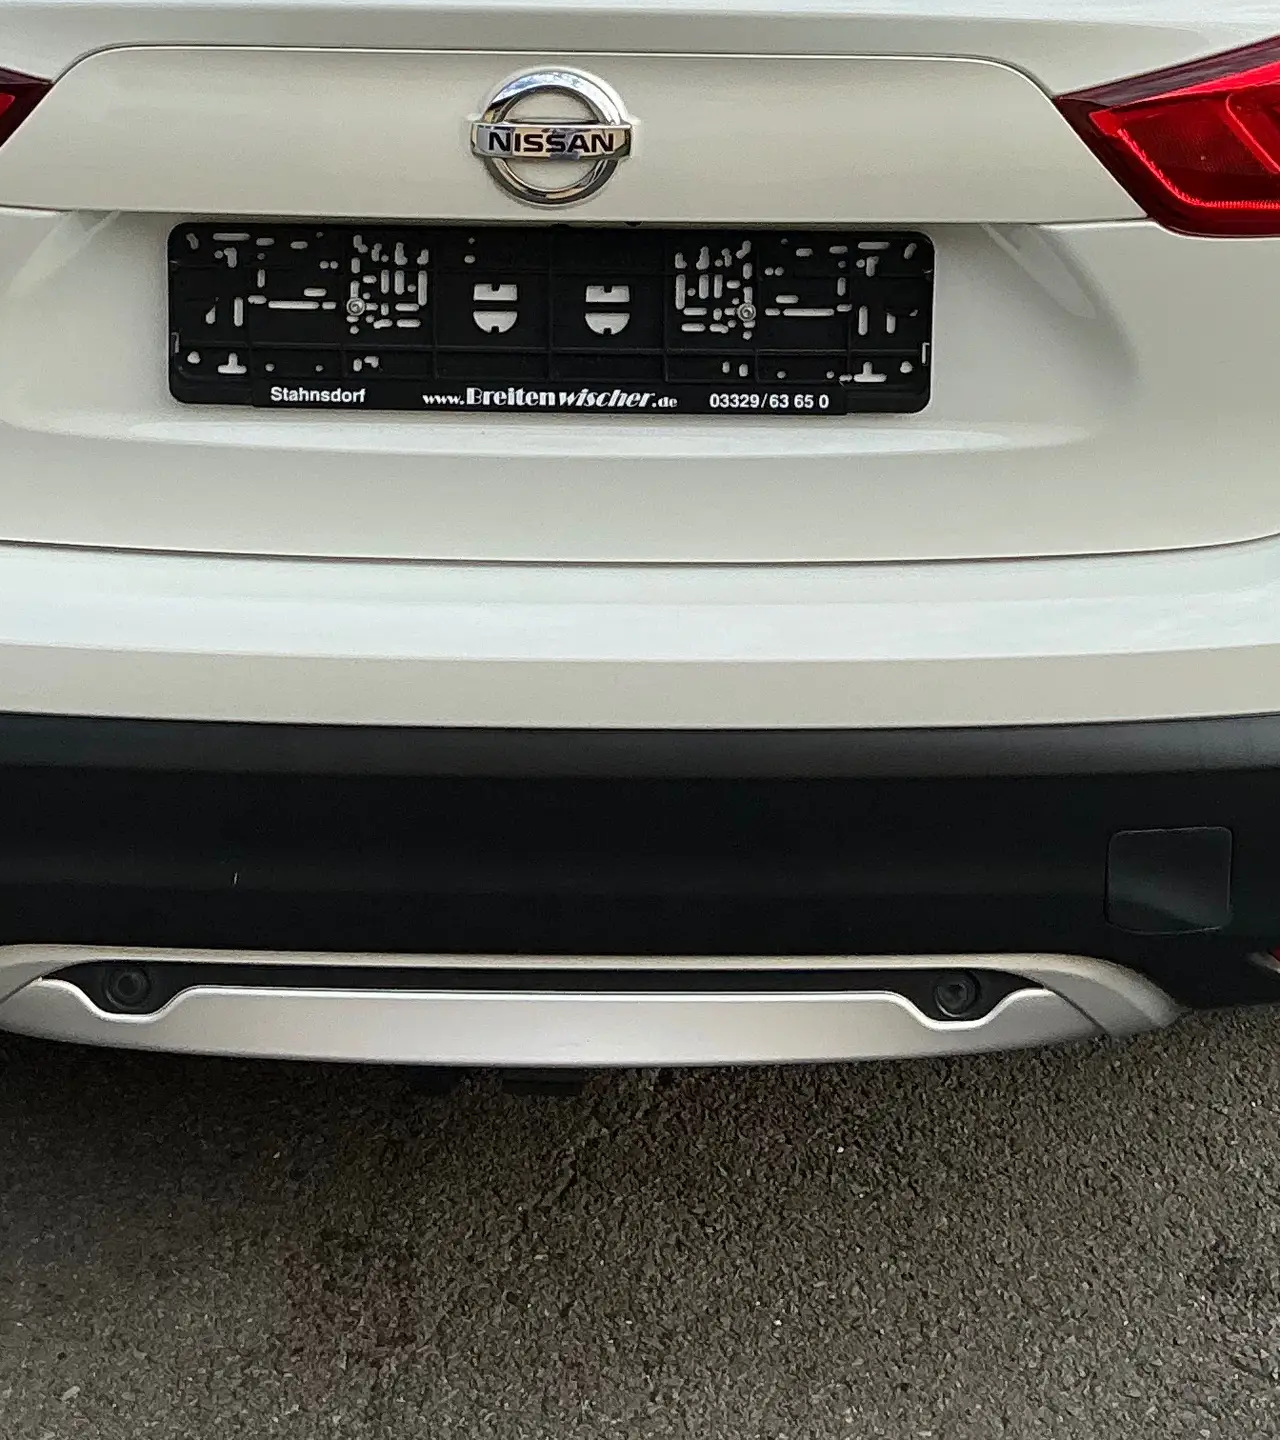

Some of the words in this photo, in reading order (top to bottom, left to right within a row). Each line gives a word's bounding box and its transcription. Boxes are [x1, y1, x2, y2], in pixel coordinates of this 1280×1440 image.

[488, 132, 614, 153] NISSAN
[270, 386, 366, 404] Stahnsdorf
[422, 387, 678, 409] www.Breitenwischer.de
[709, 393, 789, 409] 03329/63
[794, 393, 814, 409] 65
[819, 393, 830, 409] 0
